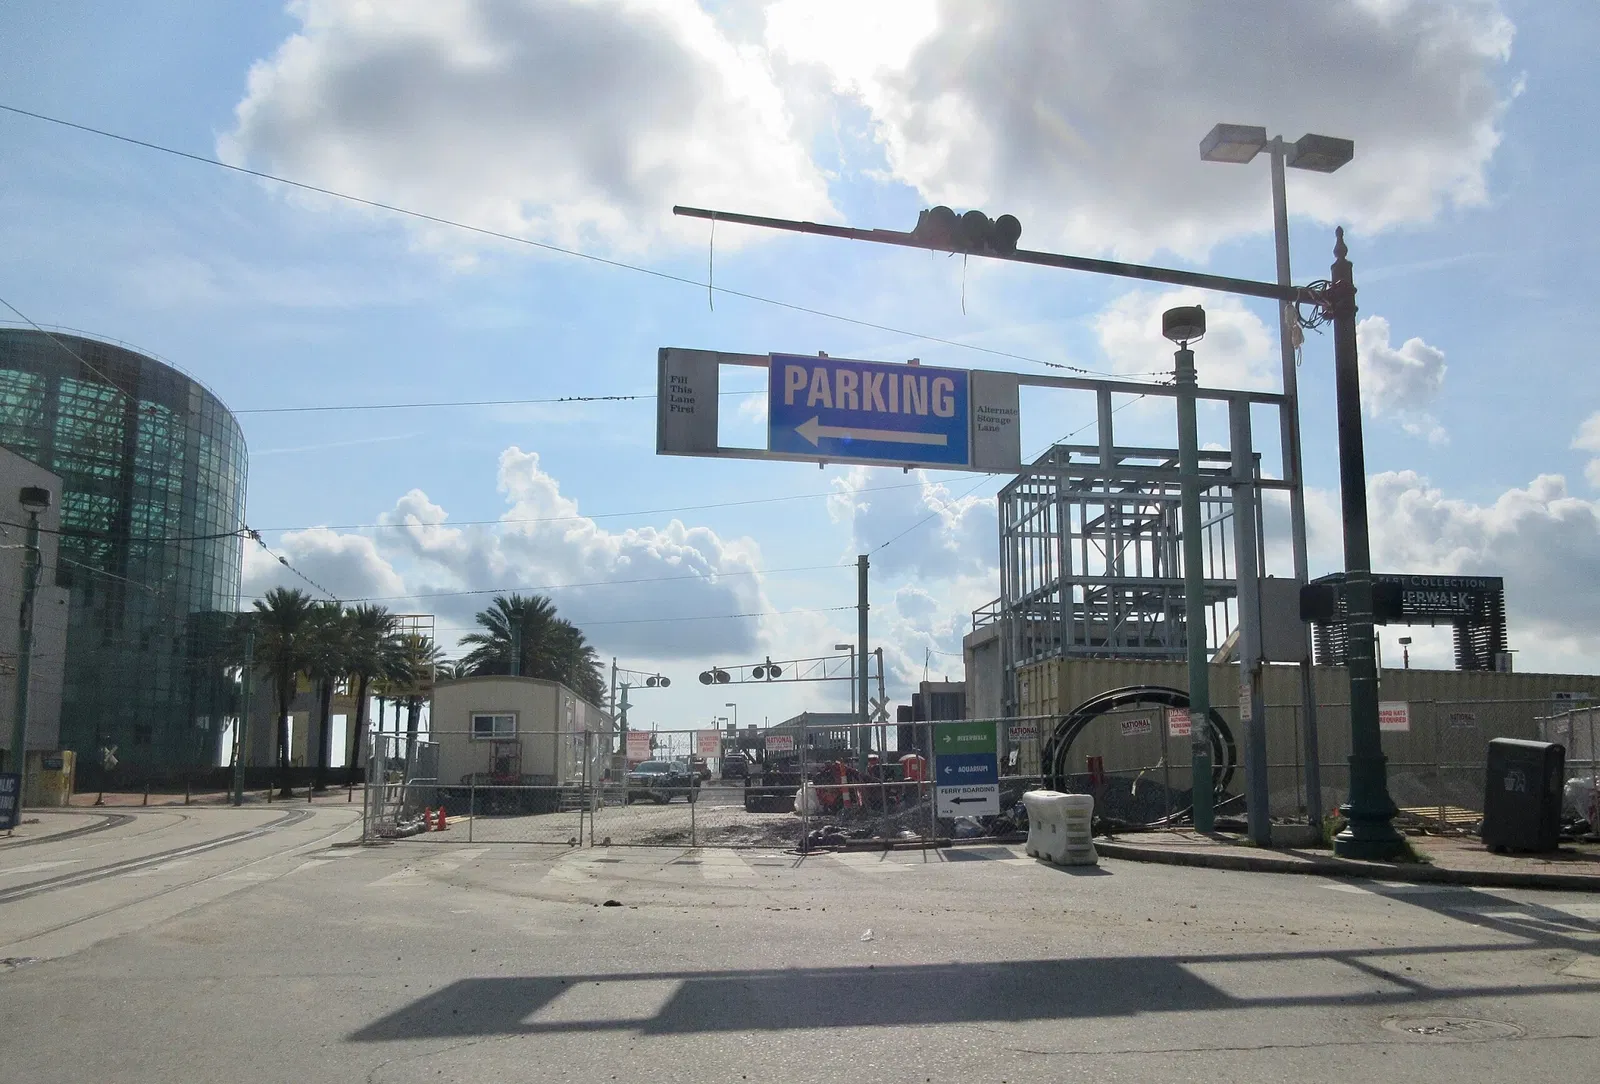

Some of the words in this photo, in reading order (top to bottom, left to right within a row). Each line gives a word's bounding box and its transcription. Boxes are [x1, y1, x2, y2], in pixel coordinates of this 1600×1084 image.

[670, 375, 688, 384] Fill
[670, 385, 692, 394] This
[784, 365, 955, 418] PARKING
[670, 395, 695, 404] Lane
[670, 405, 695, 414] First
[977, 405, 1018, 416] Alternate
[977, 414, 1011, 425] Storage
[977, 424, 1000, 432] Lane
[1411, 576, 1486, 588] COLLECTION
[1402, 591, 1470, 610] ERWALK
[1121, 718, 1150, 729] NATIONAL
[1009, 726, 1038, 735] NATIONAL
[958, 765, 989, 773] AQUARIUM
[962, 786, 995, 794] BOARDING
